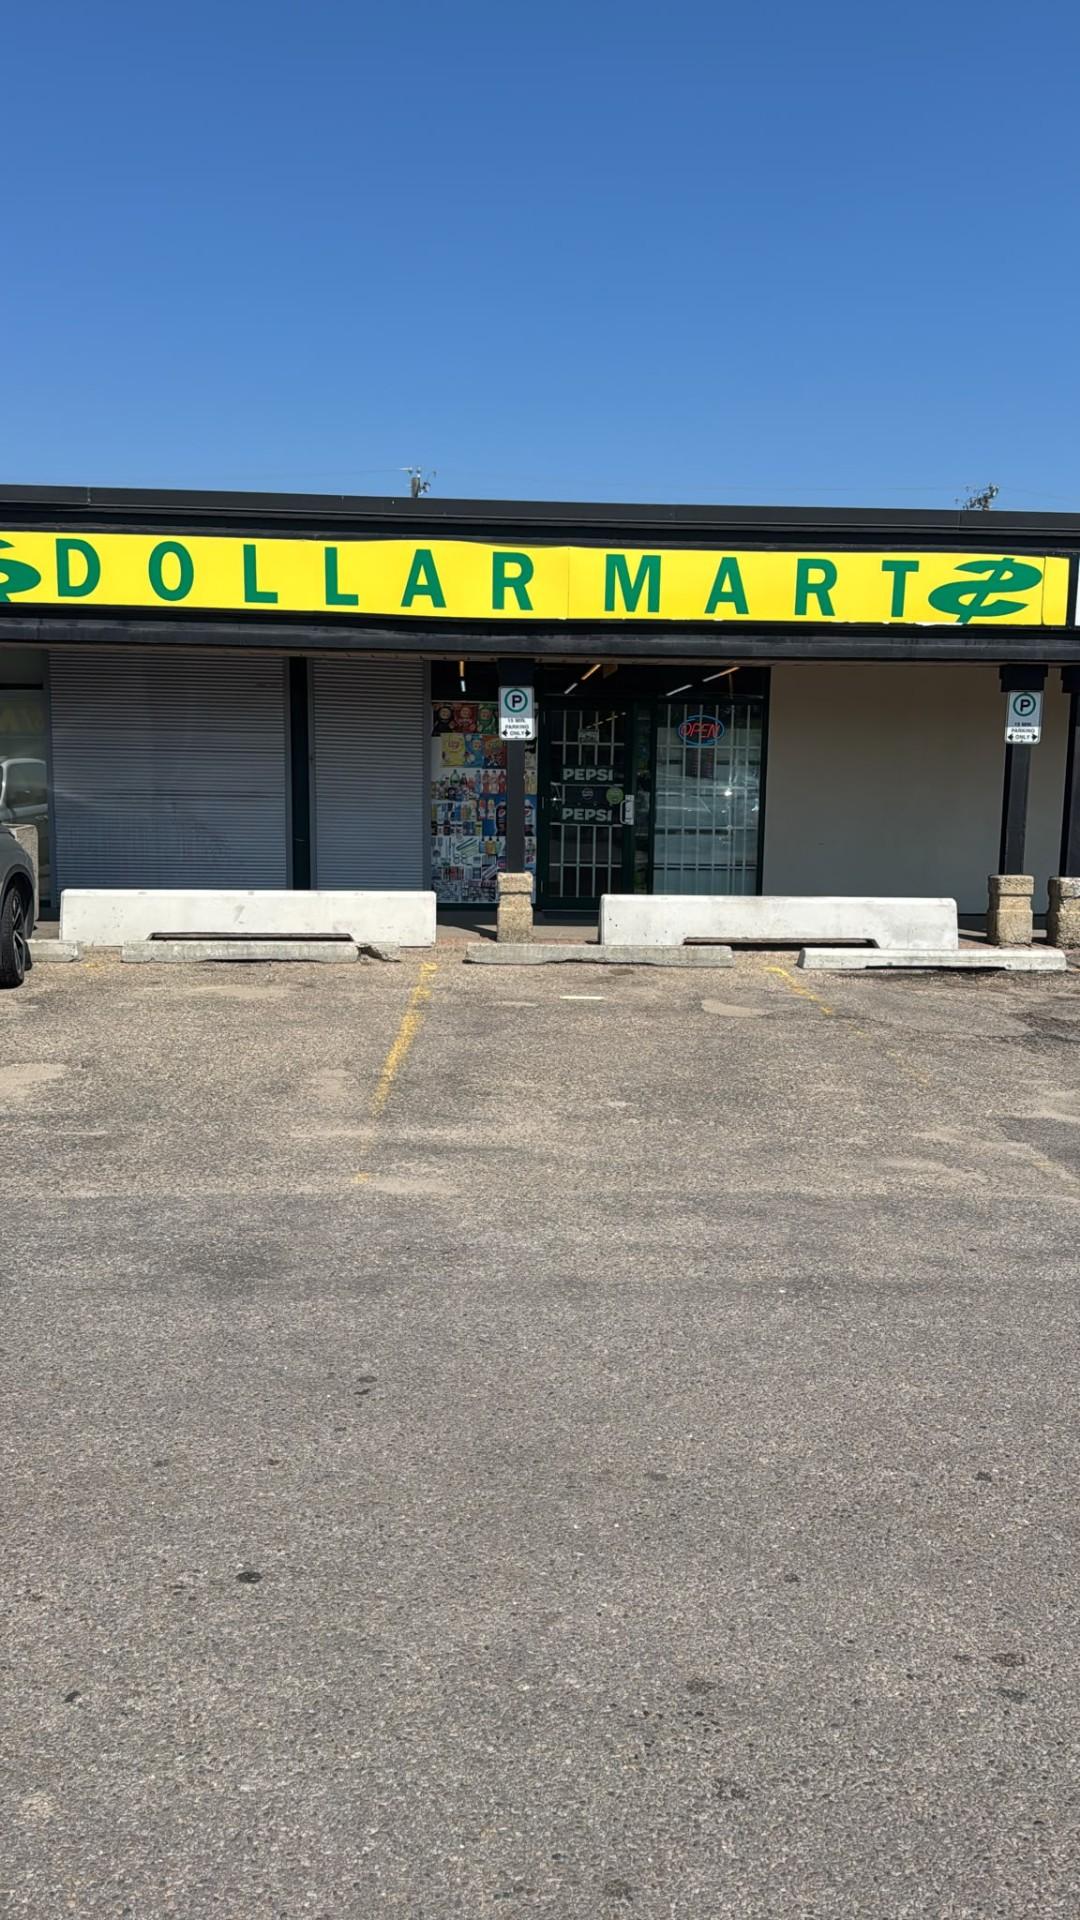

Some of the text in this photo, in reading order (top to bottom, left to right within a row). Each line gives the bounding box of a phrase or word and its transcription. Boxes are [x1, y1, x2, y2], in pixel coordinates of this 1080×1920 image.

[55, 538, 920, 618] DOLLAR MART
[511, 694, 523, 708] P
[1020, 698, 1031, 712] P
[680, 722, 720, 738] OPEN
[562, 768, 614, 781] PEPSI
[561, 807, 613, 821] PEPSI
